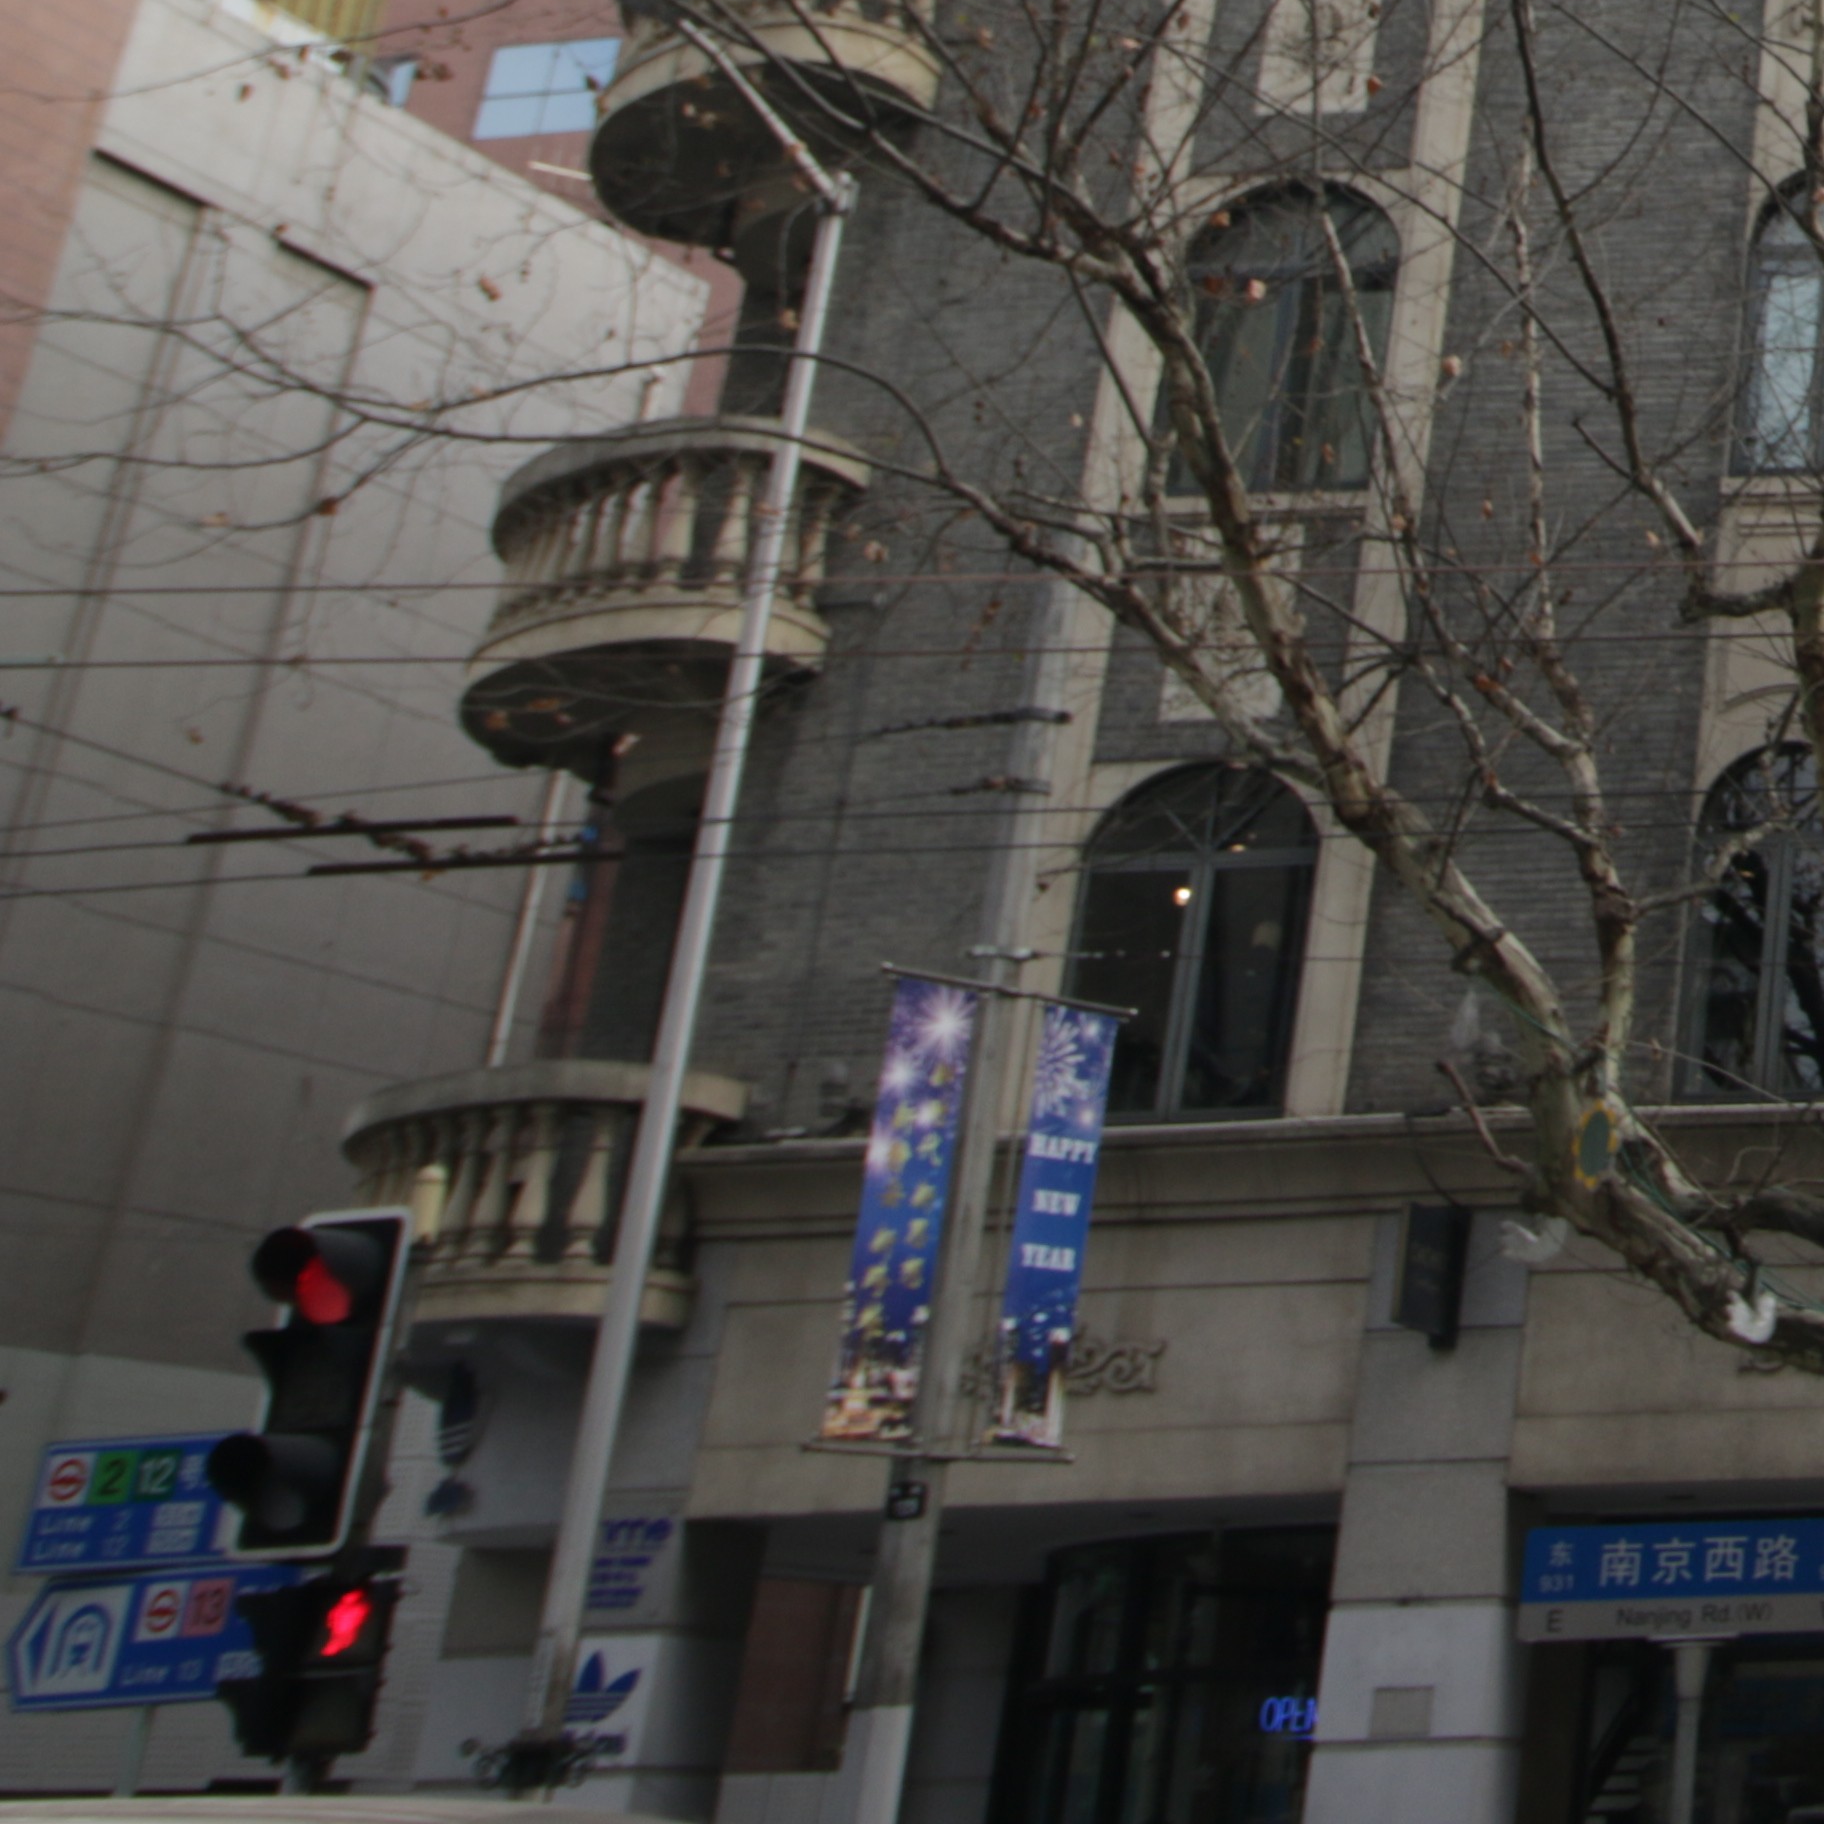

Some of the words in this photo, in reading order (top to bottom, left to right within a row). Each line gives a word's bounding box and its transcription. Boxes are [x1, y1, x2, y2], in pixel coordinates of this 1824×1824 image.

[1028, 1132, 1098, 1165] HAPPY
[1031, 1188, 1082, 1218] NEW
[1021, 1242, 1077, 1273] YEAR
[99, 1457, 128, 1497] 2
[137, 1456, 177, 1495] 12
[1549, 1541, 1576, 1568] 东
[1599, 1533, 1800, 1588] 南京西路
[1545, 1609, 1563, 1633] E
[1616, 1607, 1692, 1632] Nanjing
